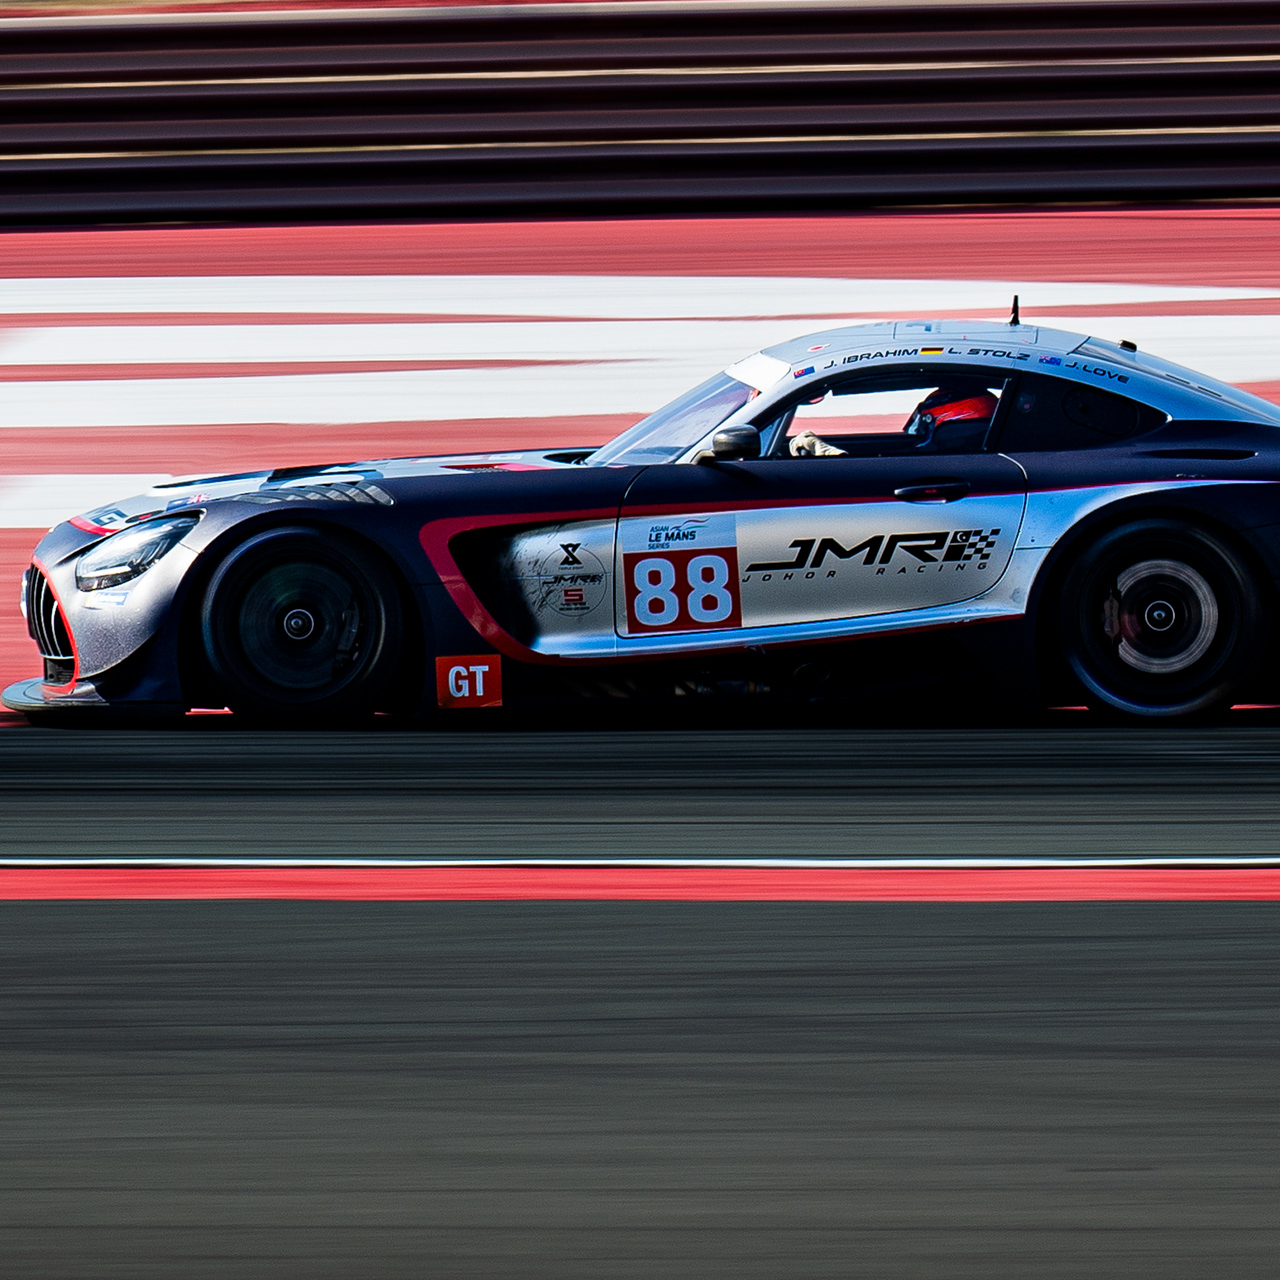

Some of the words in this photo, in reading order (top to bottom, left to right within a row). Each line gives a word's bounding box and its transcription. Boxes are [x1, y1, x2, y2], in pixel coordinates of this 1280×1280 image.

[823, 358, 838, 370] J.
[842, 347, 919, 365] IBRAHIM
[947, 347, 963, 356] L.
[966, 348, 1032, 362] STOLZ
[1065, 360, 1081, 371] J.
[1082, 364, 1131, 385] LOVE
[648, 532, 663, 543] LE
[664, 530, 697, 542] MANS
[649, 525, 670, 533] ASIAN
[647, 542, 671, 550] SERIES
[744, 531, 951, 573] JMR
[741, 570, 838, 583] JOHOR
[875, 561, 988, 576] RACING
[633, 554, 733, 627] 88
[448, 664, 490, 698] GT
